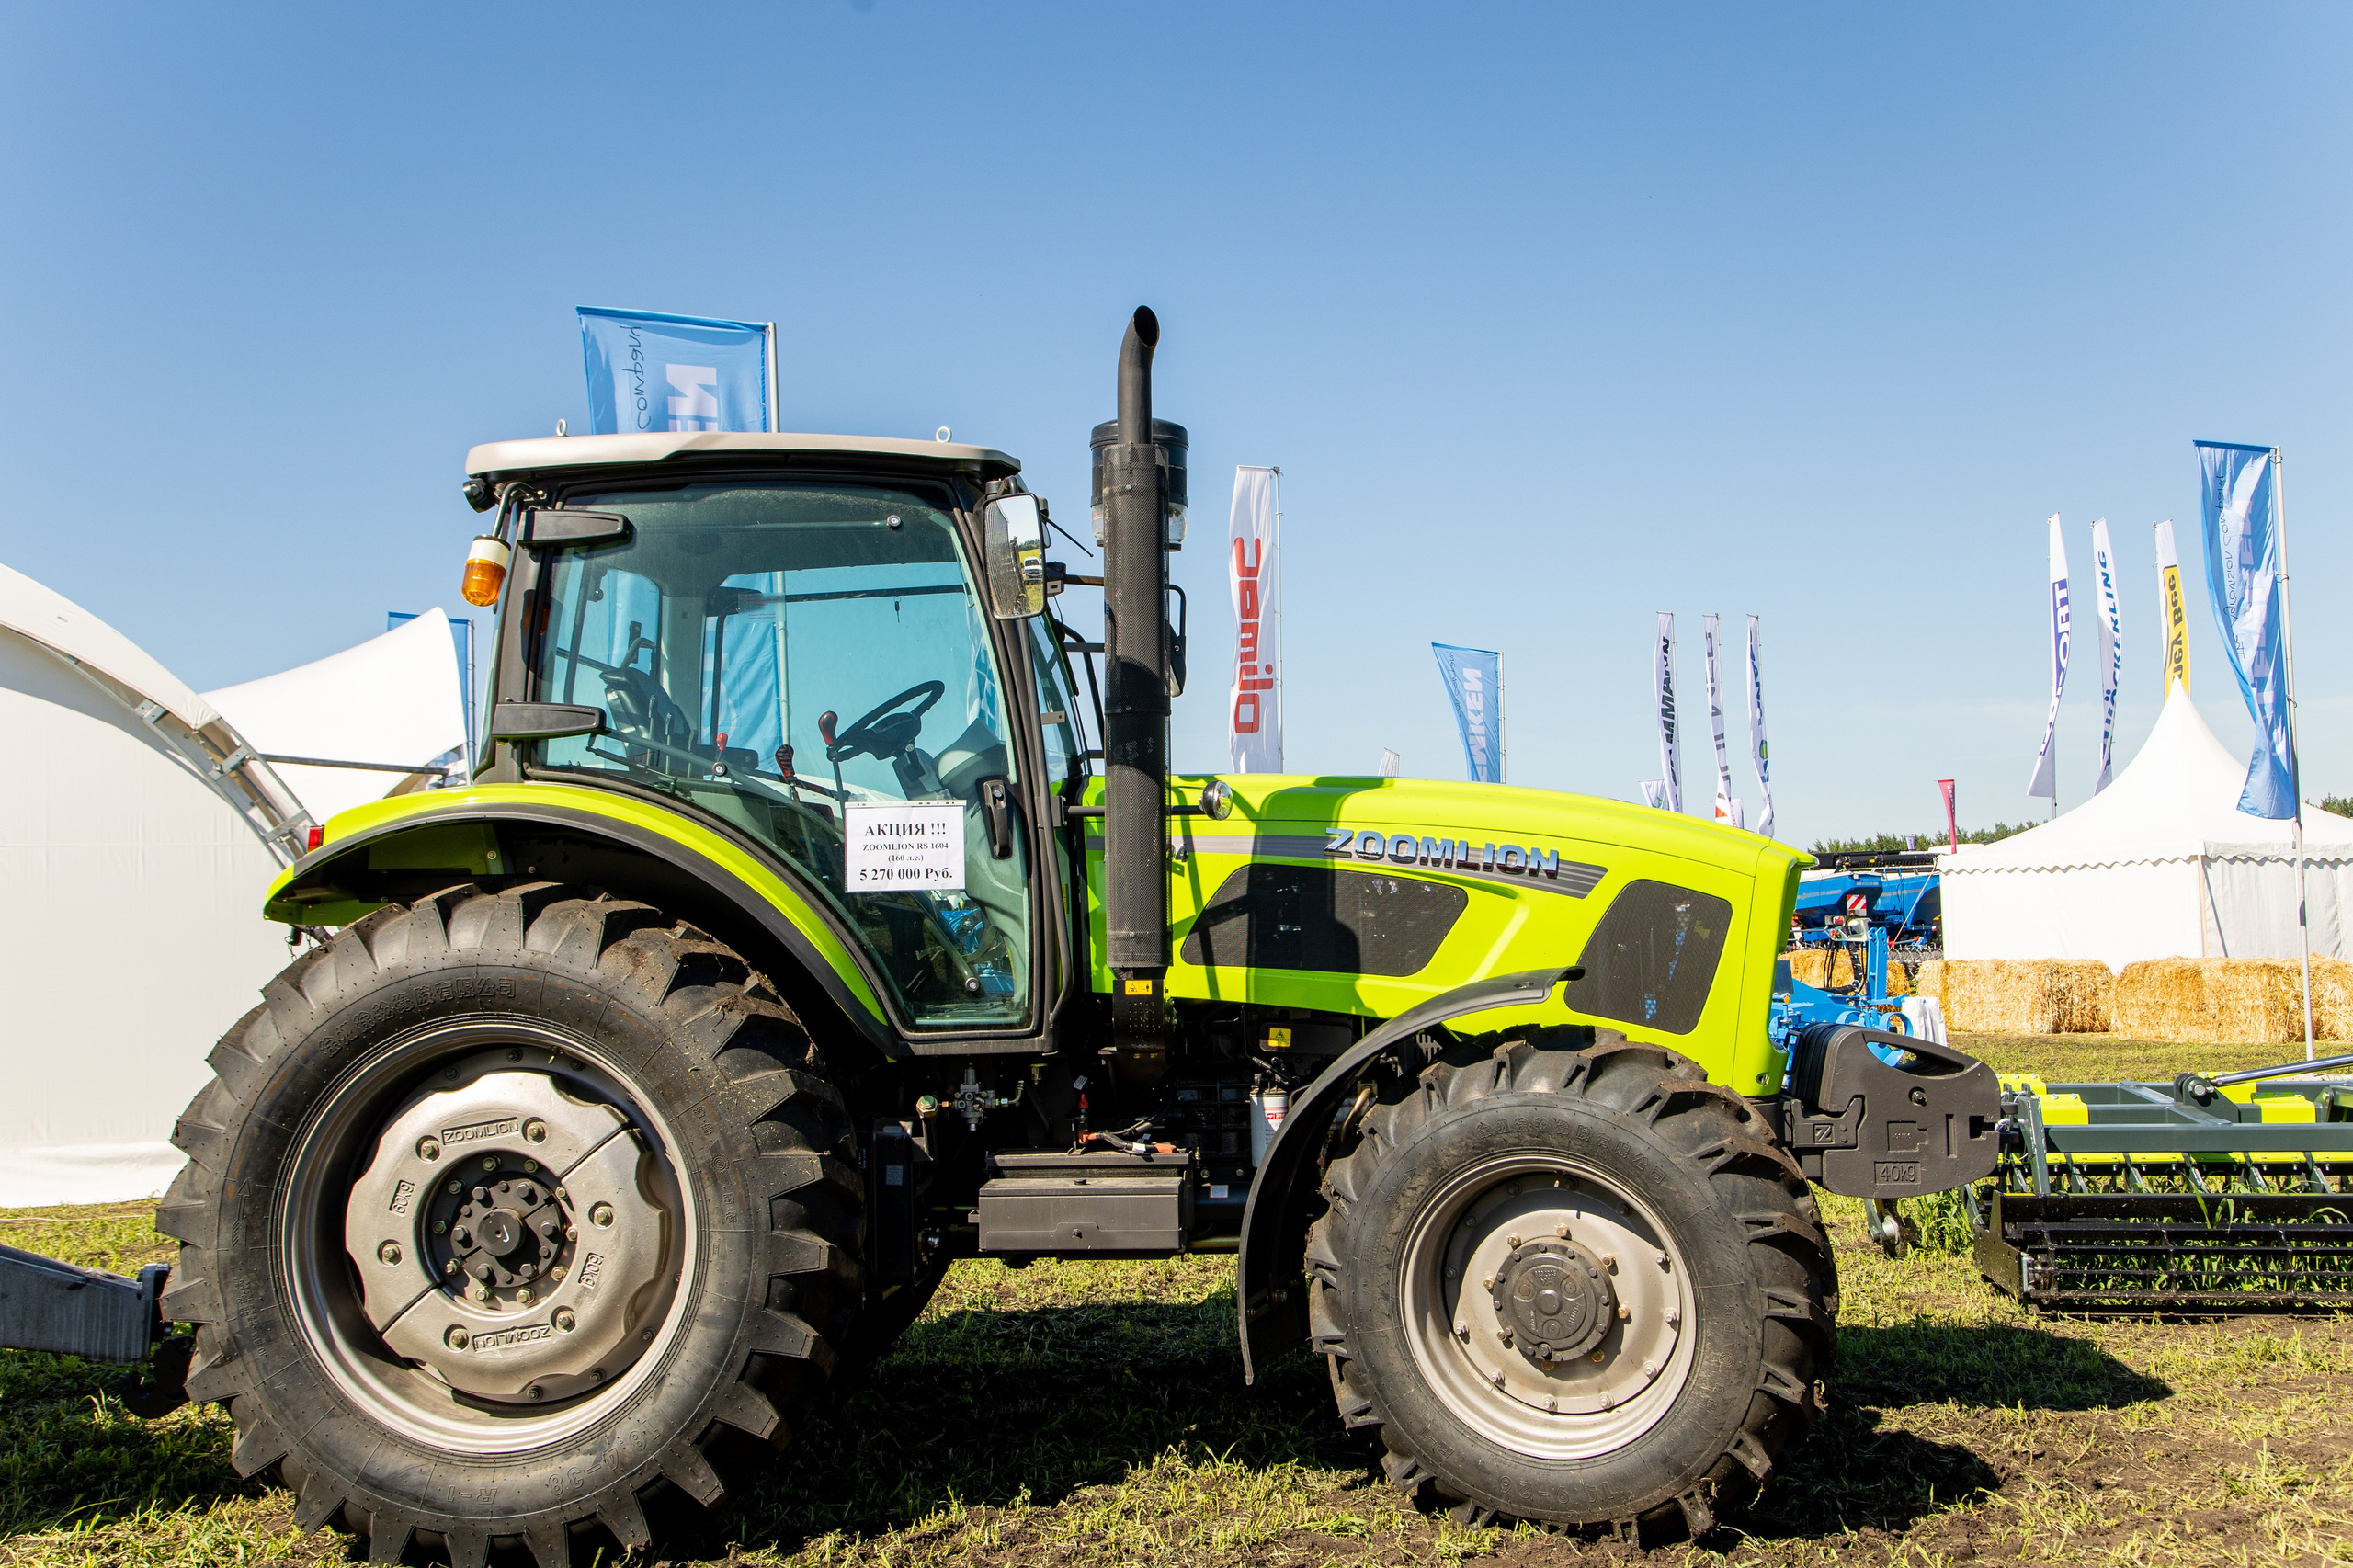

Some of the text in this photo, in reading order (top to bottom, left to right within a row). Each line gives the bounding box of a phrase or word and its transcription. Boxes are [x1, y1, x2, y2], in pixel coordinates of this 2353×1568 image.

[864, 822, 946, 837] АКЦИЯ !!!
[862, 843, 915, 851] ZOOMLION
[1324, 827, 1559, 880] ZOOMLION
[888, 855, 904, 863] (160
[859, 868, 953, 881] 5 270 000 Руб.
[443, 1118, 521, 1144] ZOOMLION
[1879, 1164, 1918, 1183] 40kg
[473, 1324, 551, 1351] ZOOMLION
